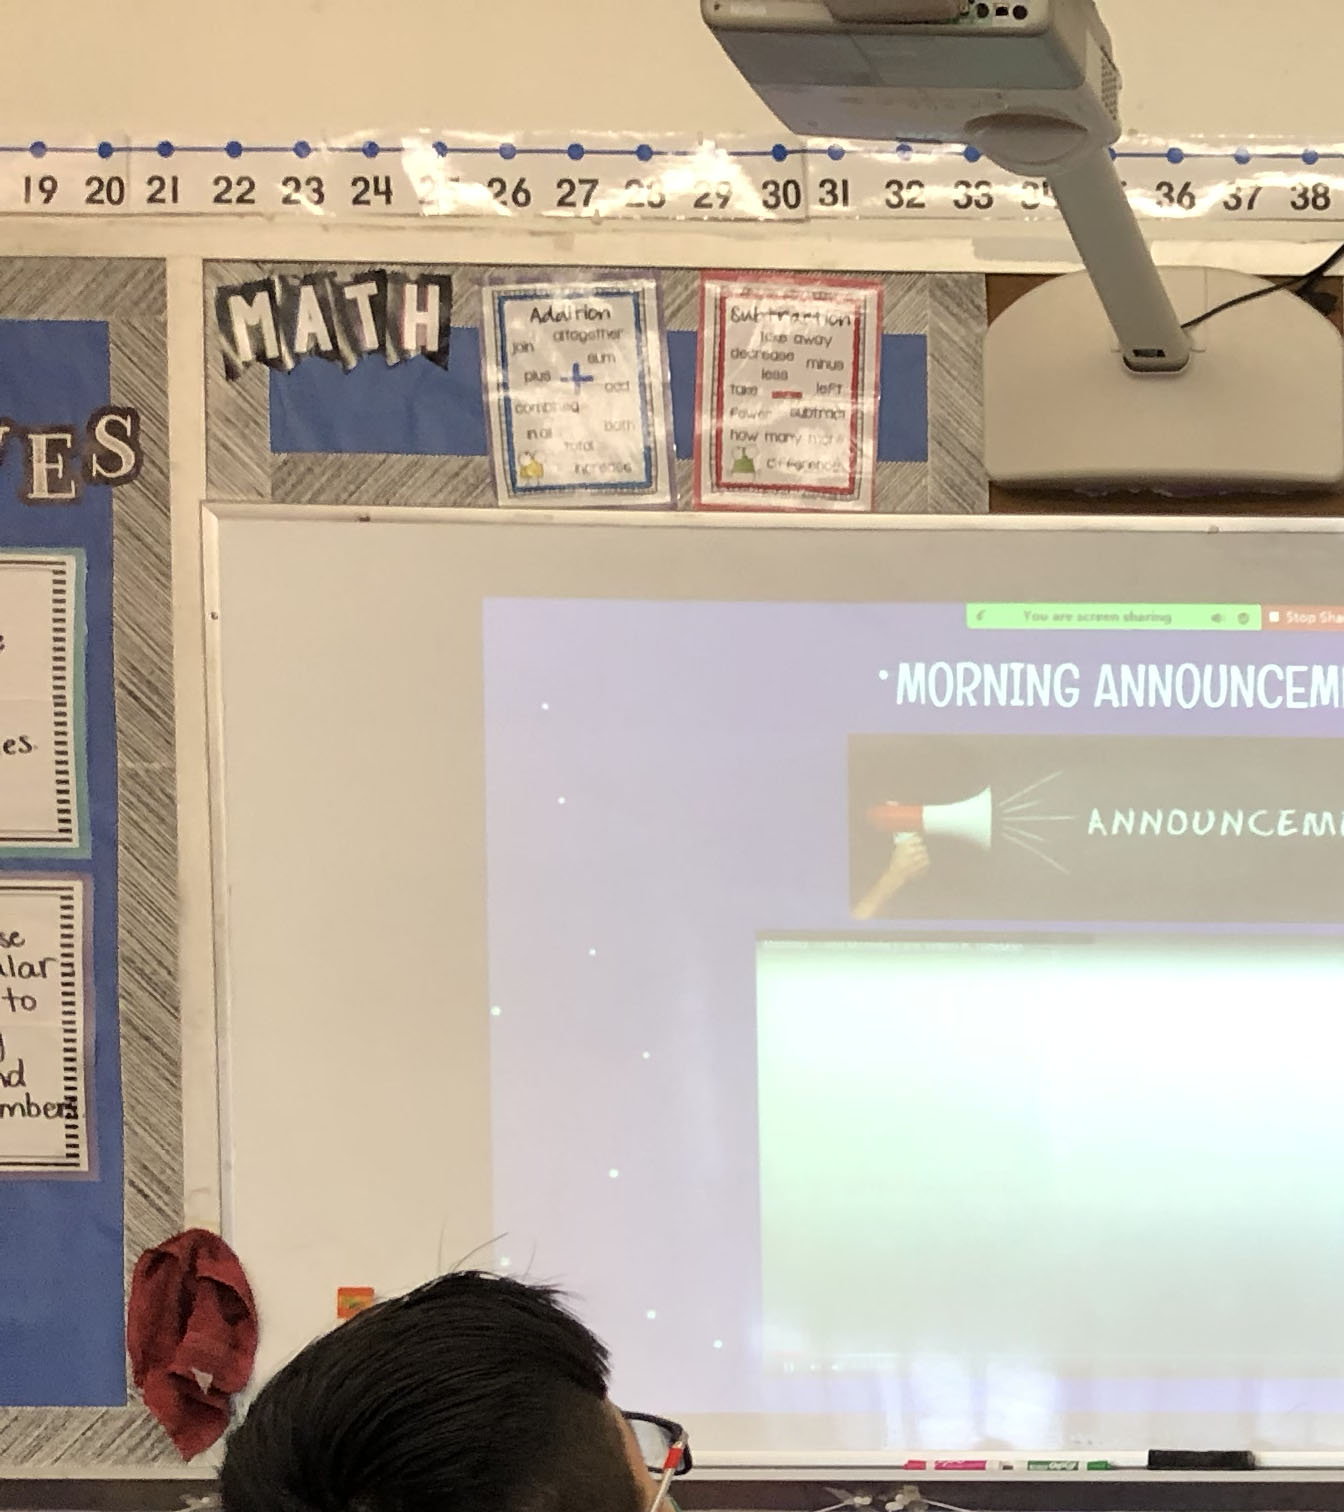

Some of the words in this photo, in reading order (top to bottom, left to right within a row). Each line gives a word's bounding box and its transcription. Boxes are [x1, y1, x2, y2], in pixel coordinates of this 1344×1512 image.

[85, 176, 125, 205] 20
[213, 176, 255, 204] 22
[762, 180, 801, 209] 30
[818, 179, 848, 207] 31
[231, 281, 442, 366] MATH
[793, 335, 832, 349] away
[524, 370, 551, 384] plus
[0, 415, 135, 499] ES
[1023, 611, 1049, 622] You
[1053, 612, 1073, 622] are
[1077, 612, 1116, 622] screen
[1119, 611, 1172, 624] sharing
[1285, 612, 1315, 624] Stop
[896, 662, 1080, 707] MORNING
